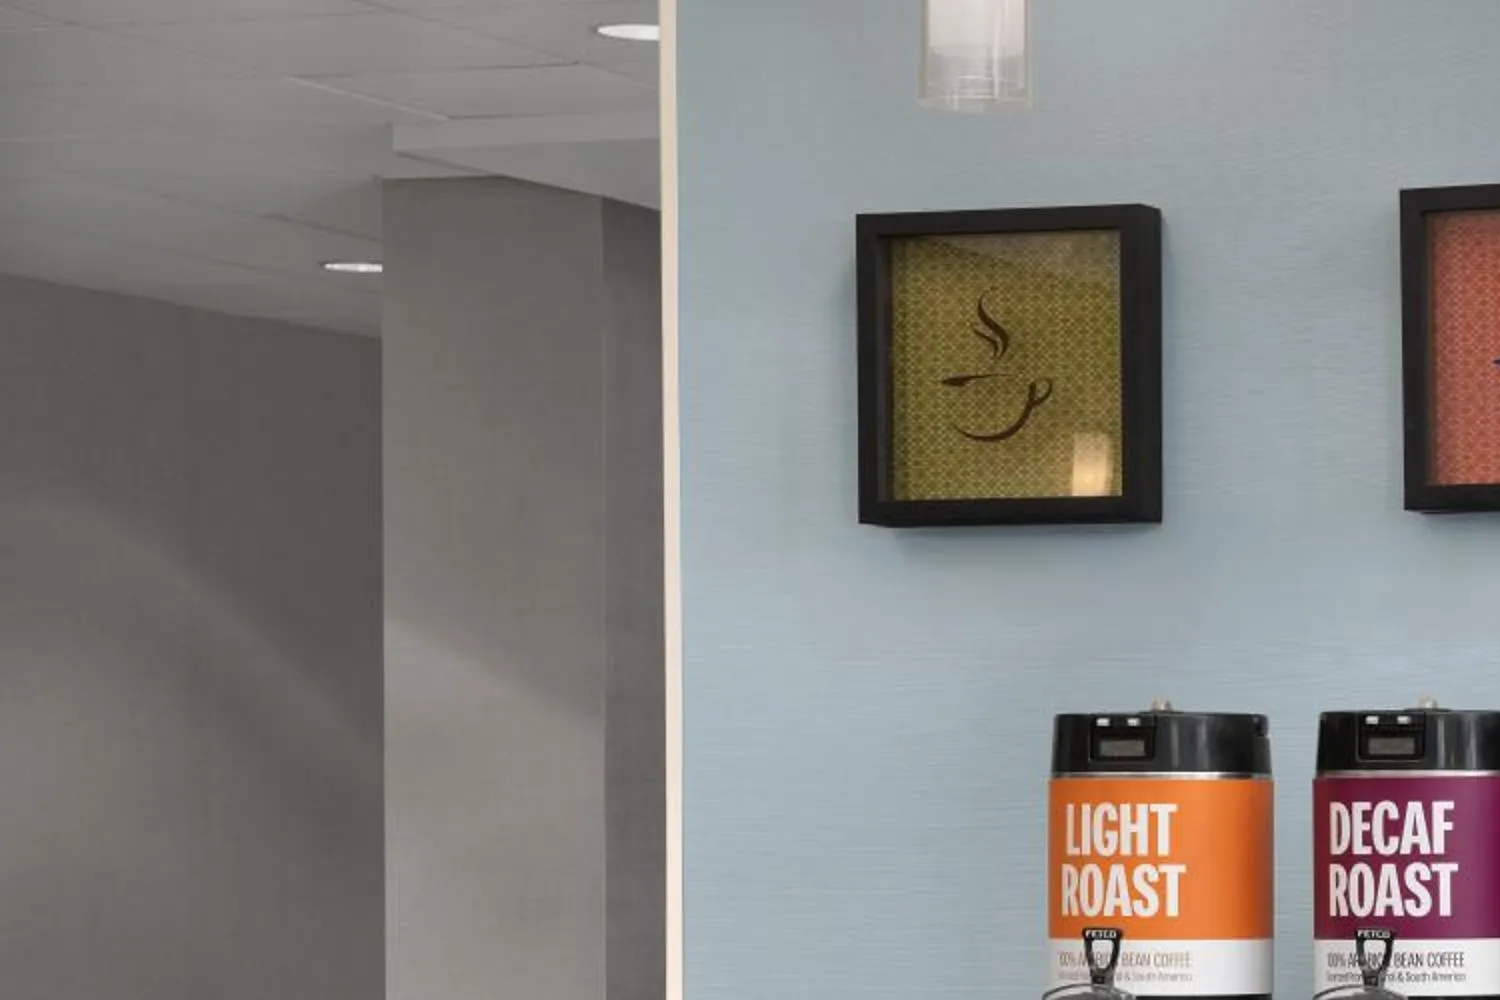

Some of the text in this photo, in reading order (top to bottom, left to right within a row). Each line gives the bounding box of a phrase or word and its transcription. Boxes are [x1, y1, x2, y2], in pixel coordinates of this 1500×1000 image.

[1066, 802, 1178, 857] LIGHT
[1329, 800, 1454, 856] DECAF
[1061, 864, 1187, 918] ROAST
[1329, 862, 1459, 918] ROAST
[1085, 929, 1117, 939] FETCO
[1121, 951, 1151, 968] BEAN
[1153, 951, 1193, 968] COFFEE
[1393, 952, 1424, 968] BEAN
[1427, 952, 1465, 968] COFFEE
